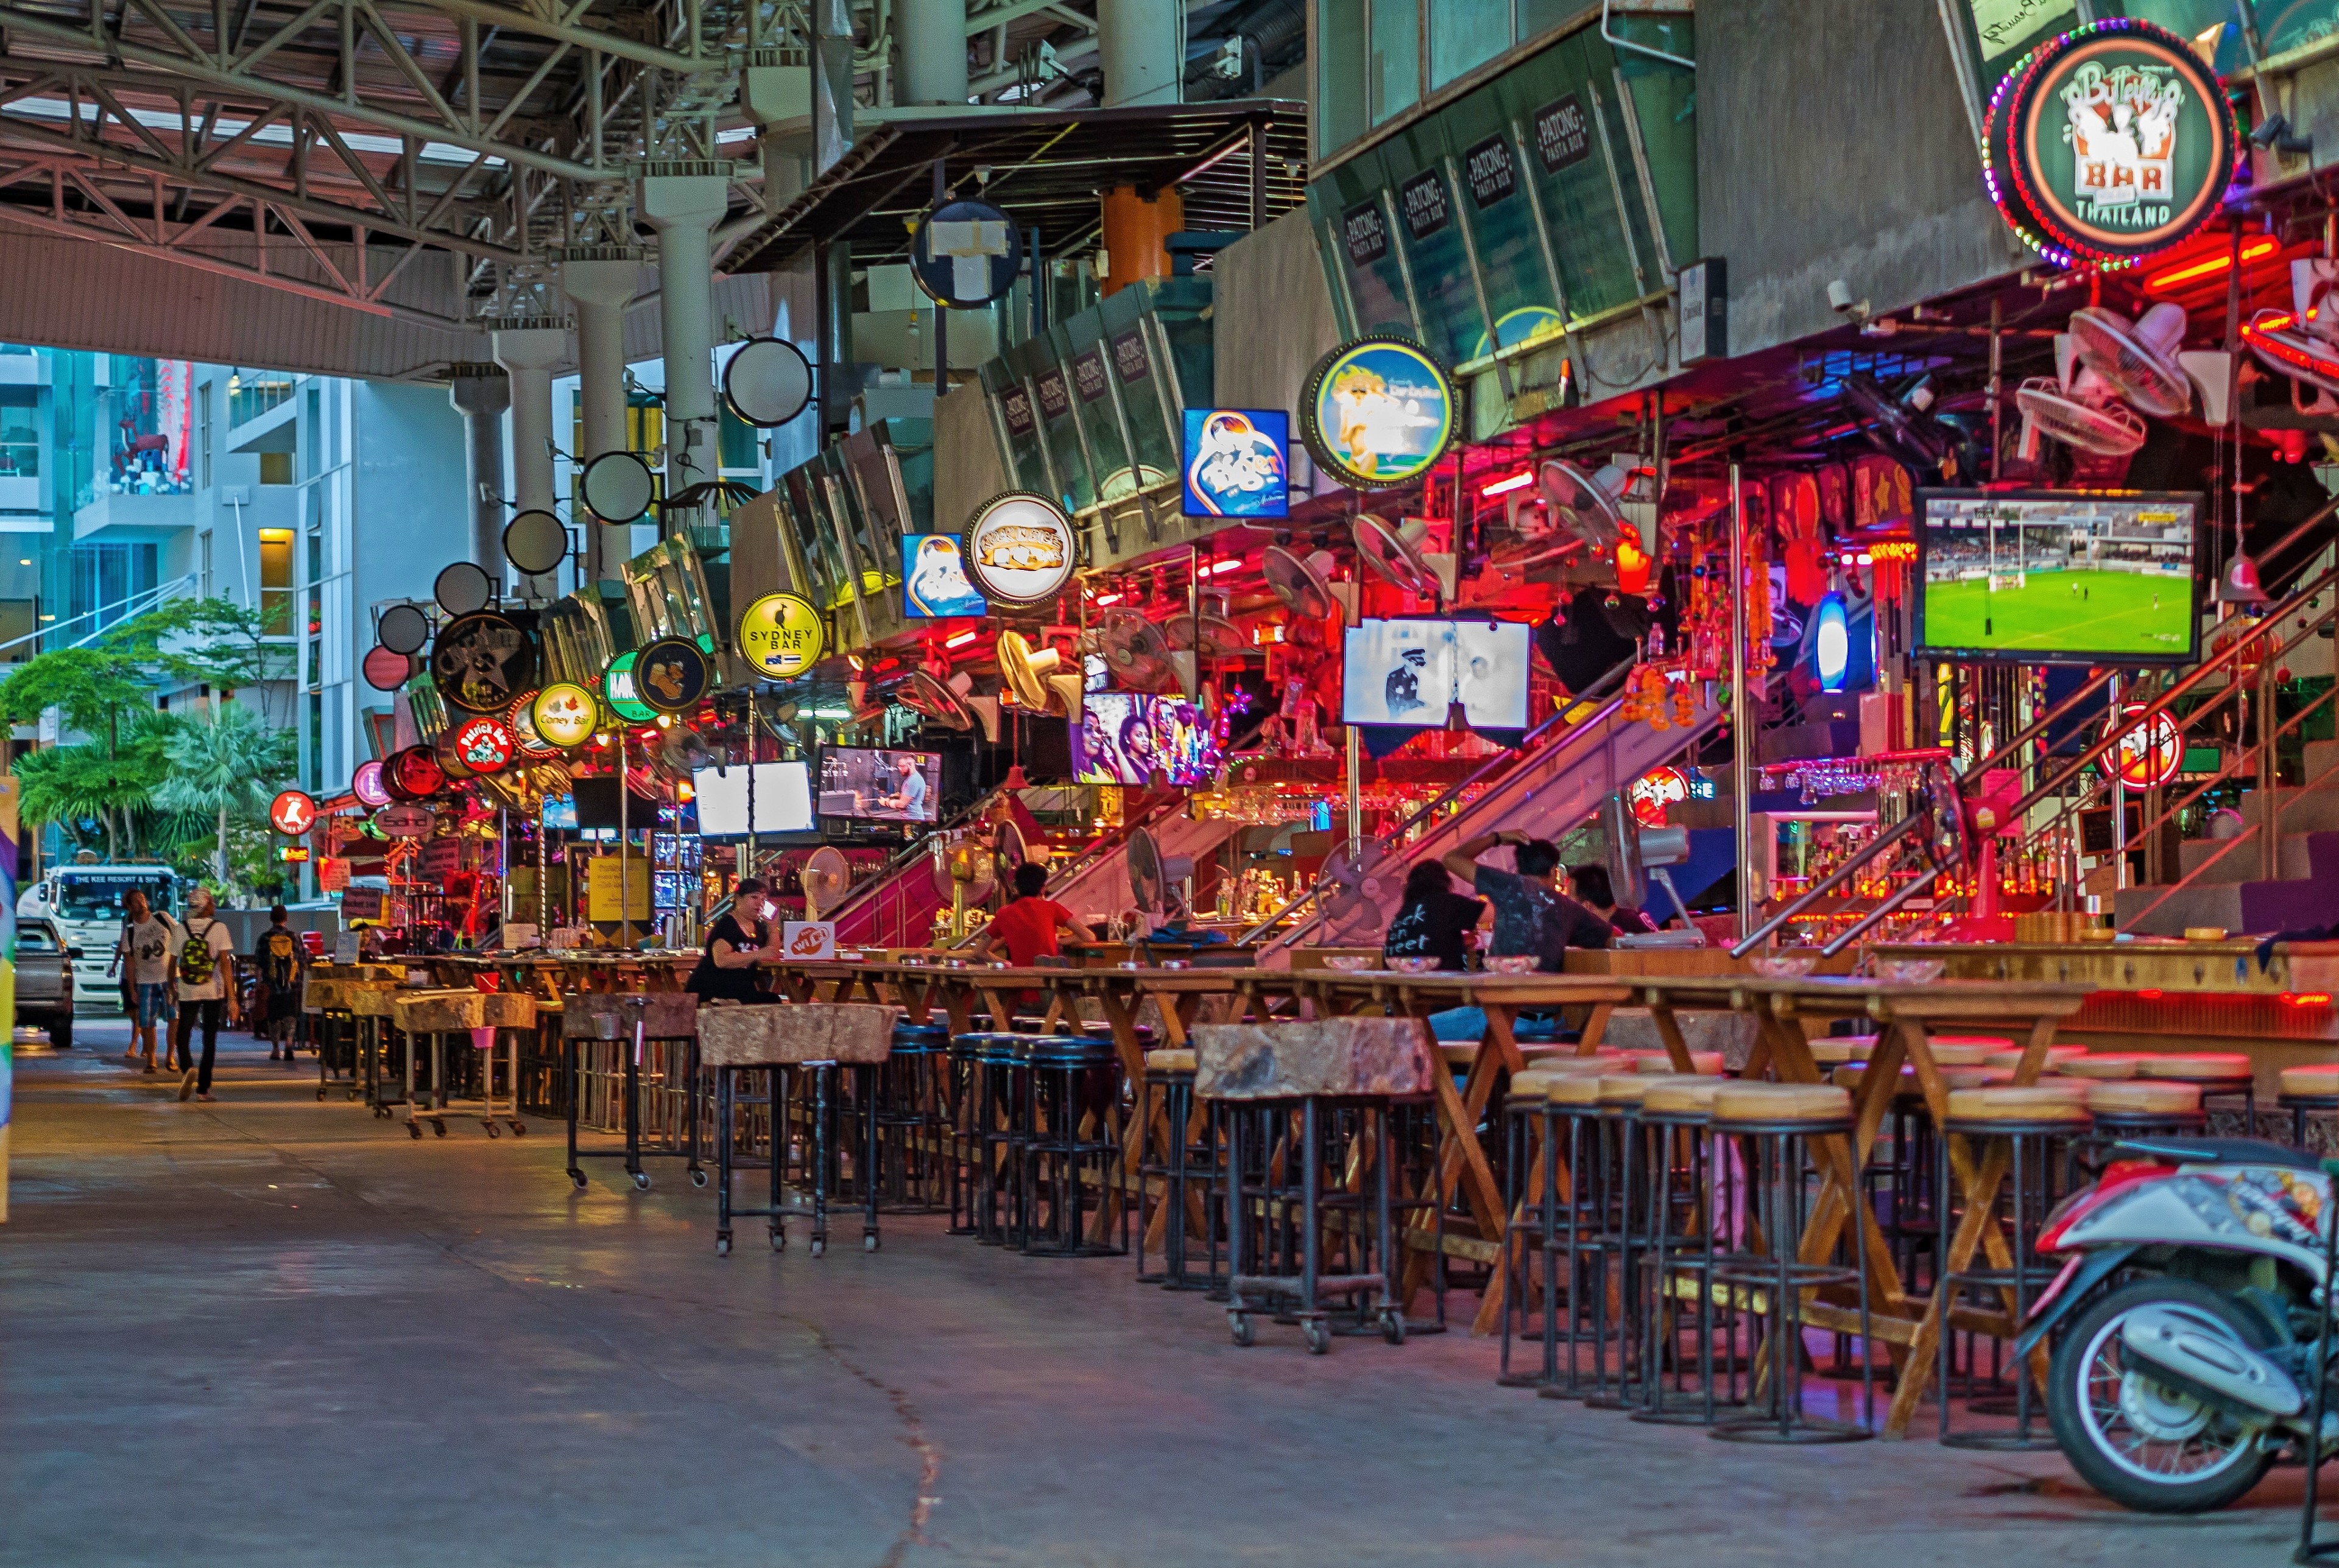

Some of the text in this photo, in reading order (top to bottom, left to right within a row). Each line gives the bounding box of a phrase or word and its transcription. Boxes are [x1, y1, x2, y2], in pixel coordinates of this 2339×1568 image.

[1539, 105, 1579, 145] PATONG
[1546, 133, 1584, 163] PASTA BOX
[1470, 143, 1506, 181] PATONG
[1495, 170, 1511, 188] BOX
[2085, 164, 2161, 191] BAR
[1405, 178, 1439, 214] PATONG
[1347, 209, 1378, 242] PATONG
[2076, 200, 2170, 226] THAILAND
[750, 629, 813, 641] SYDNEY
[771, 640, 801, 650] BAR
[540, 714, 590, 726] Coney Bar
[632, 709, 651, 718] BAR
[460, 723, 509, 747] Patrick Bar
